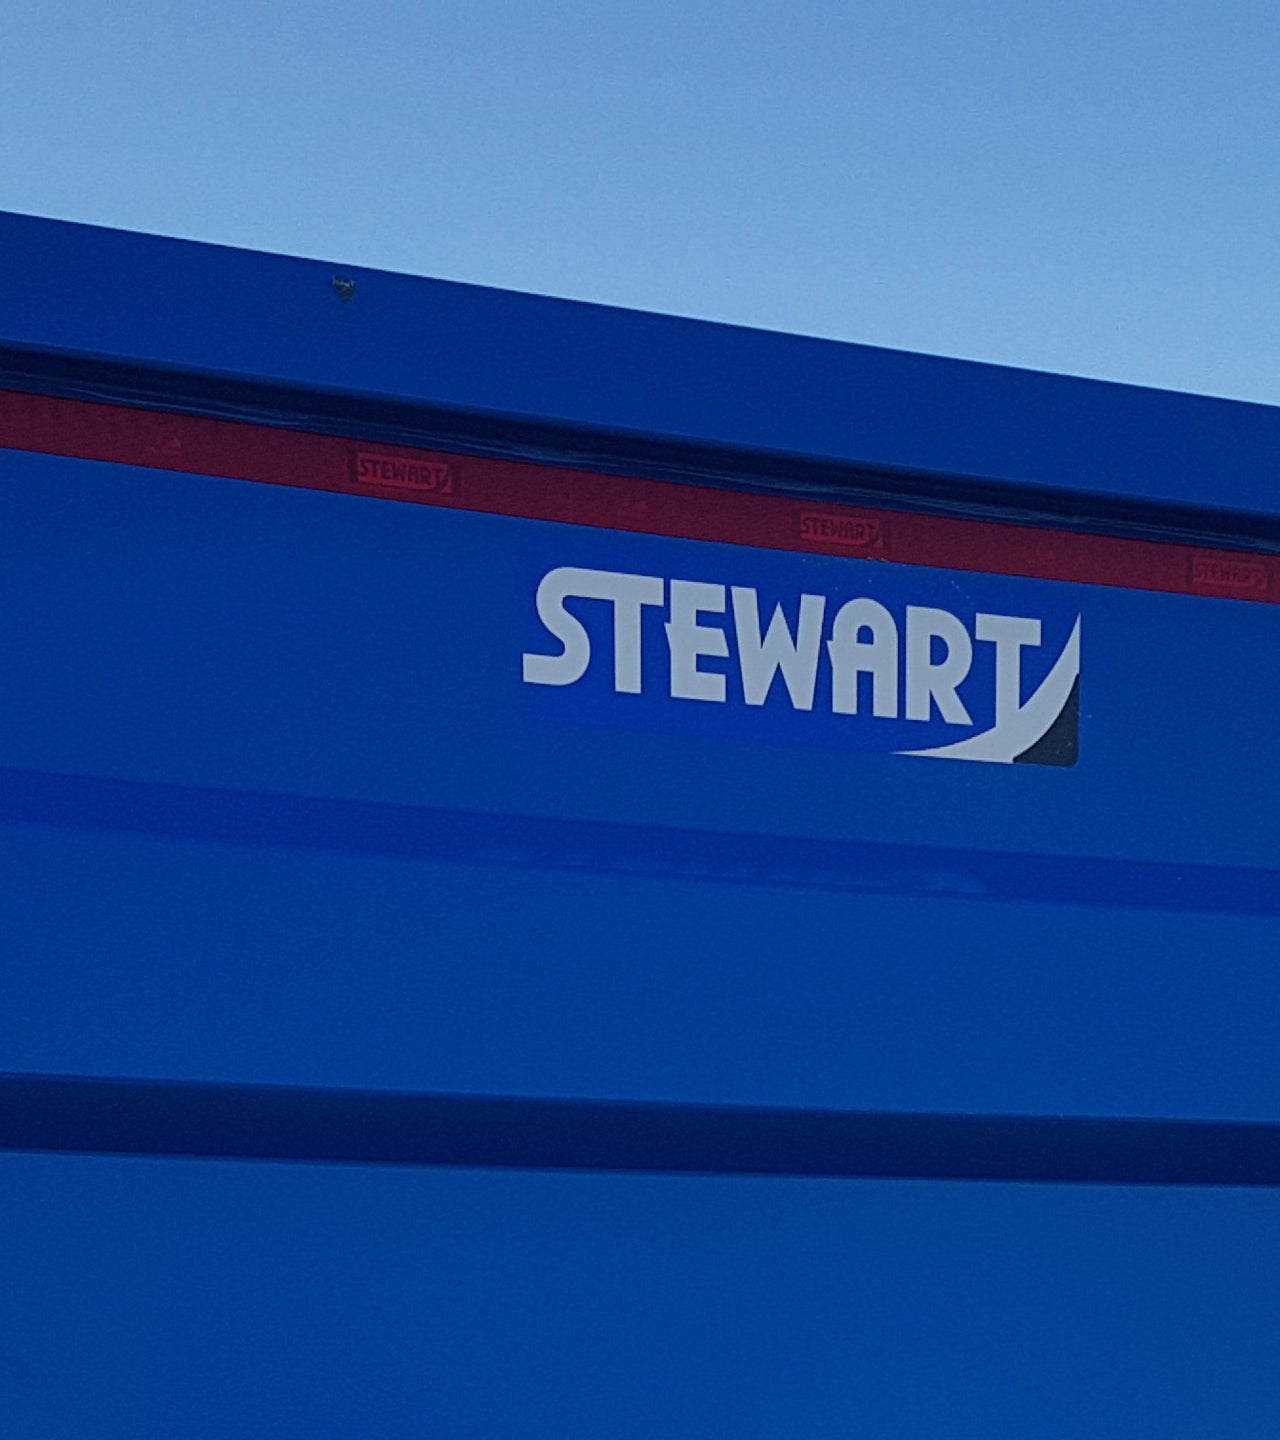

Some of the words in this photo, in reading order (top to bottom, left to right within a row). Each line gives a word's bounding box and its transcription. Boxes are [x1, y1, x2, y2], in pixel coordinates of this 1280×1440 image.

[358, 457, 450, 493] STEWART
[801, 515, 882, 547] STEWART
[523, 566, 1081, 764] STEWART
